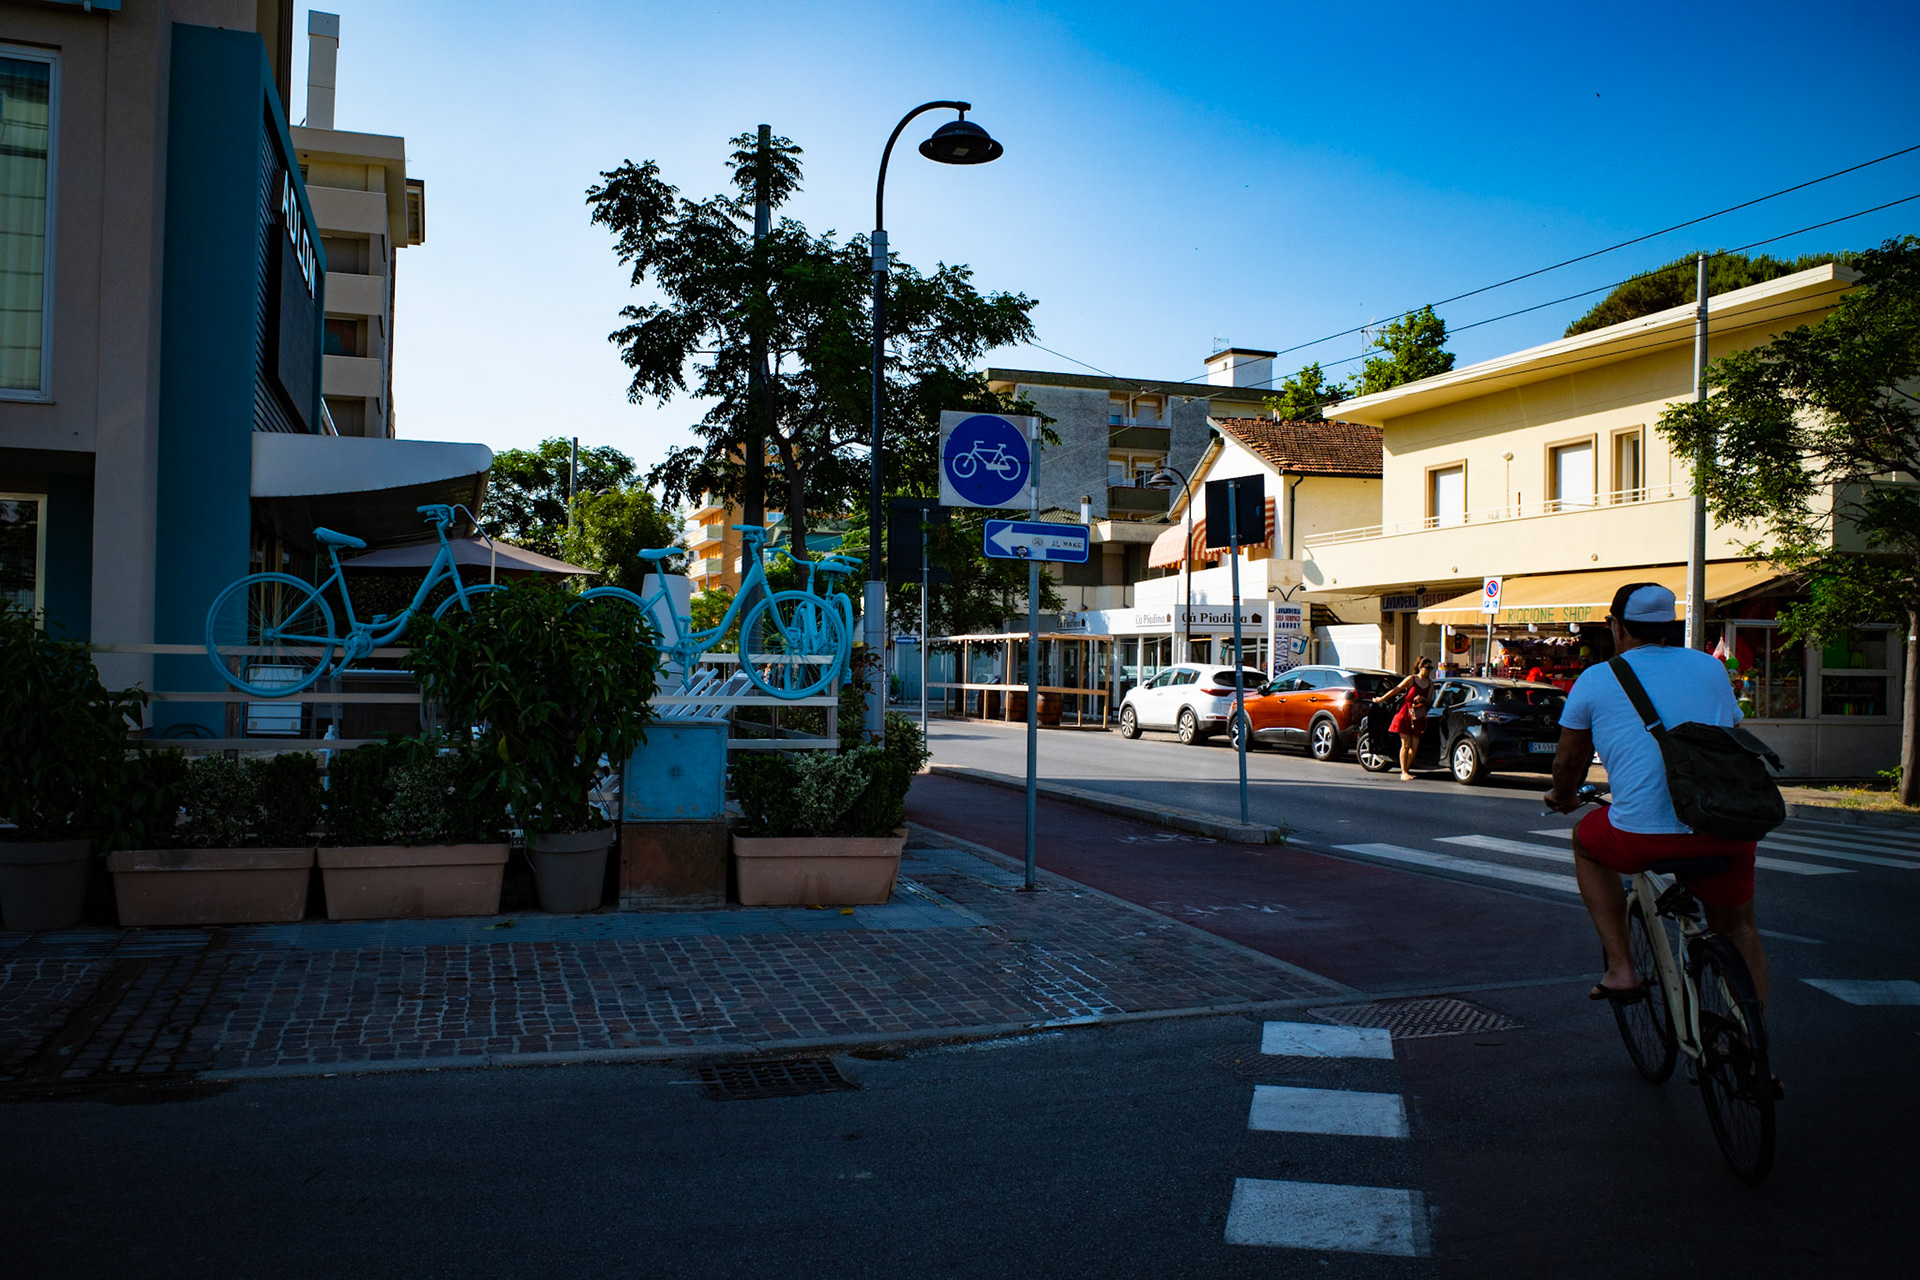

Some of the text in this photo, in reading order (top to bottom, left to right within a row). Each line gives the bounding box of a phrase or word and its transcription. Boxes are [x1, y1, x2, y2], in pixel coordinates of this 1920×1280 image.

[281, 168, 316, 300] ADLON
[1382, 595, 1419, 610] LAVANDERIA
[1275, 607, 1301, 615] LAVANDERIA
[1507, 606, 1592, 622] RICCIONE SHOP
[1143, 613, 1165, 625] Piadina
[1275, 633, 1289, 667] WASH
